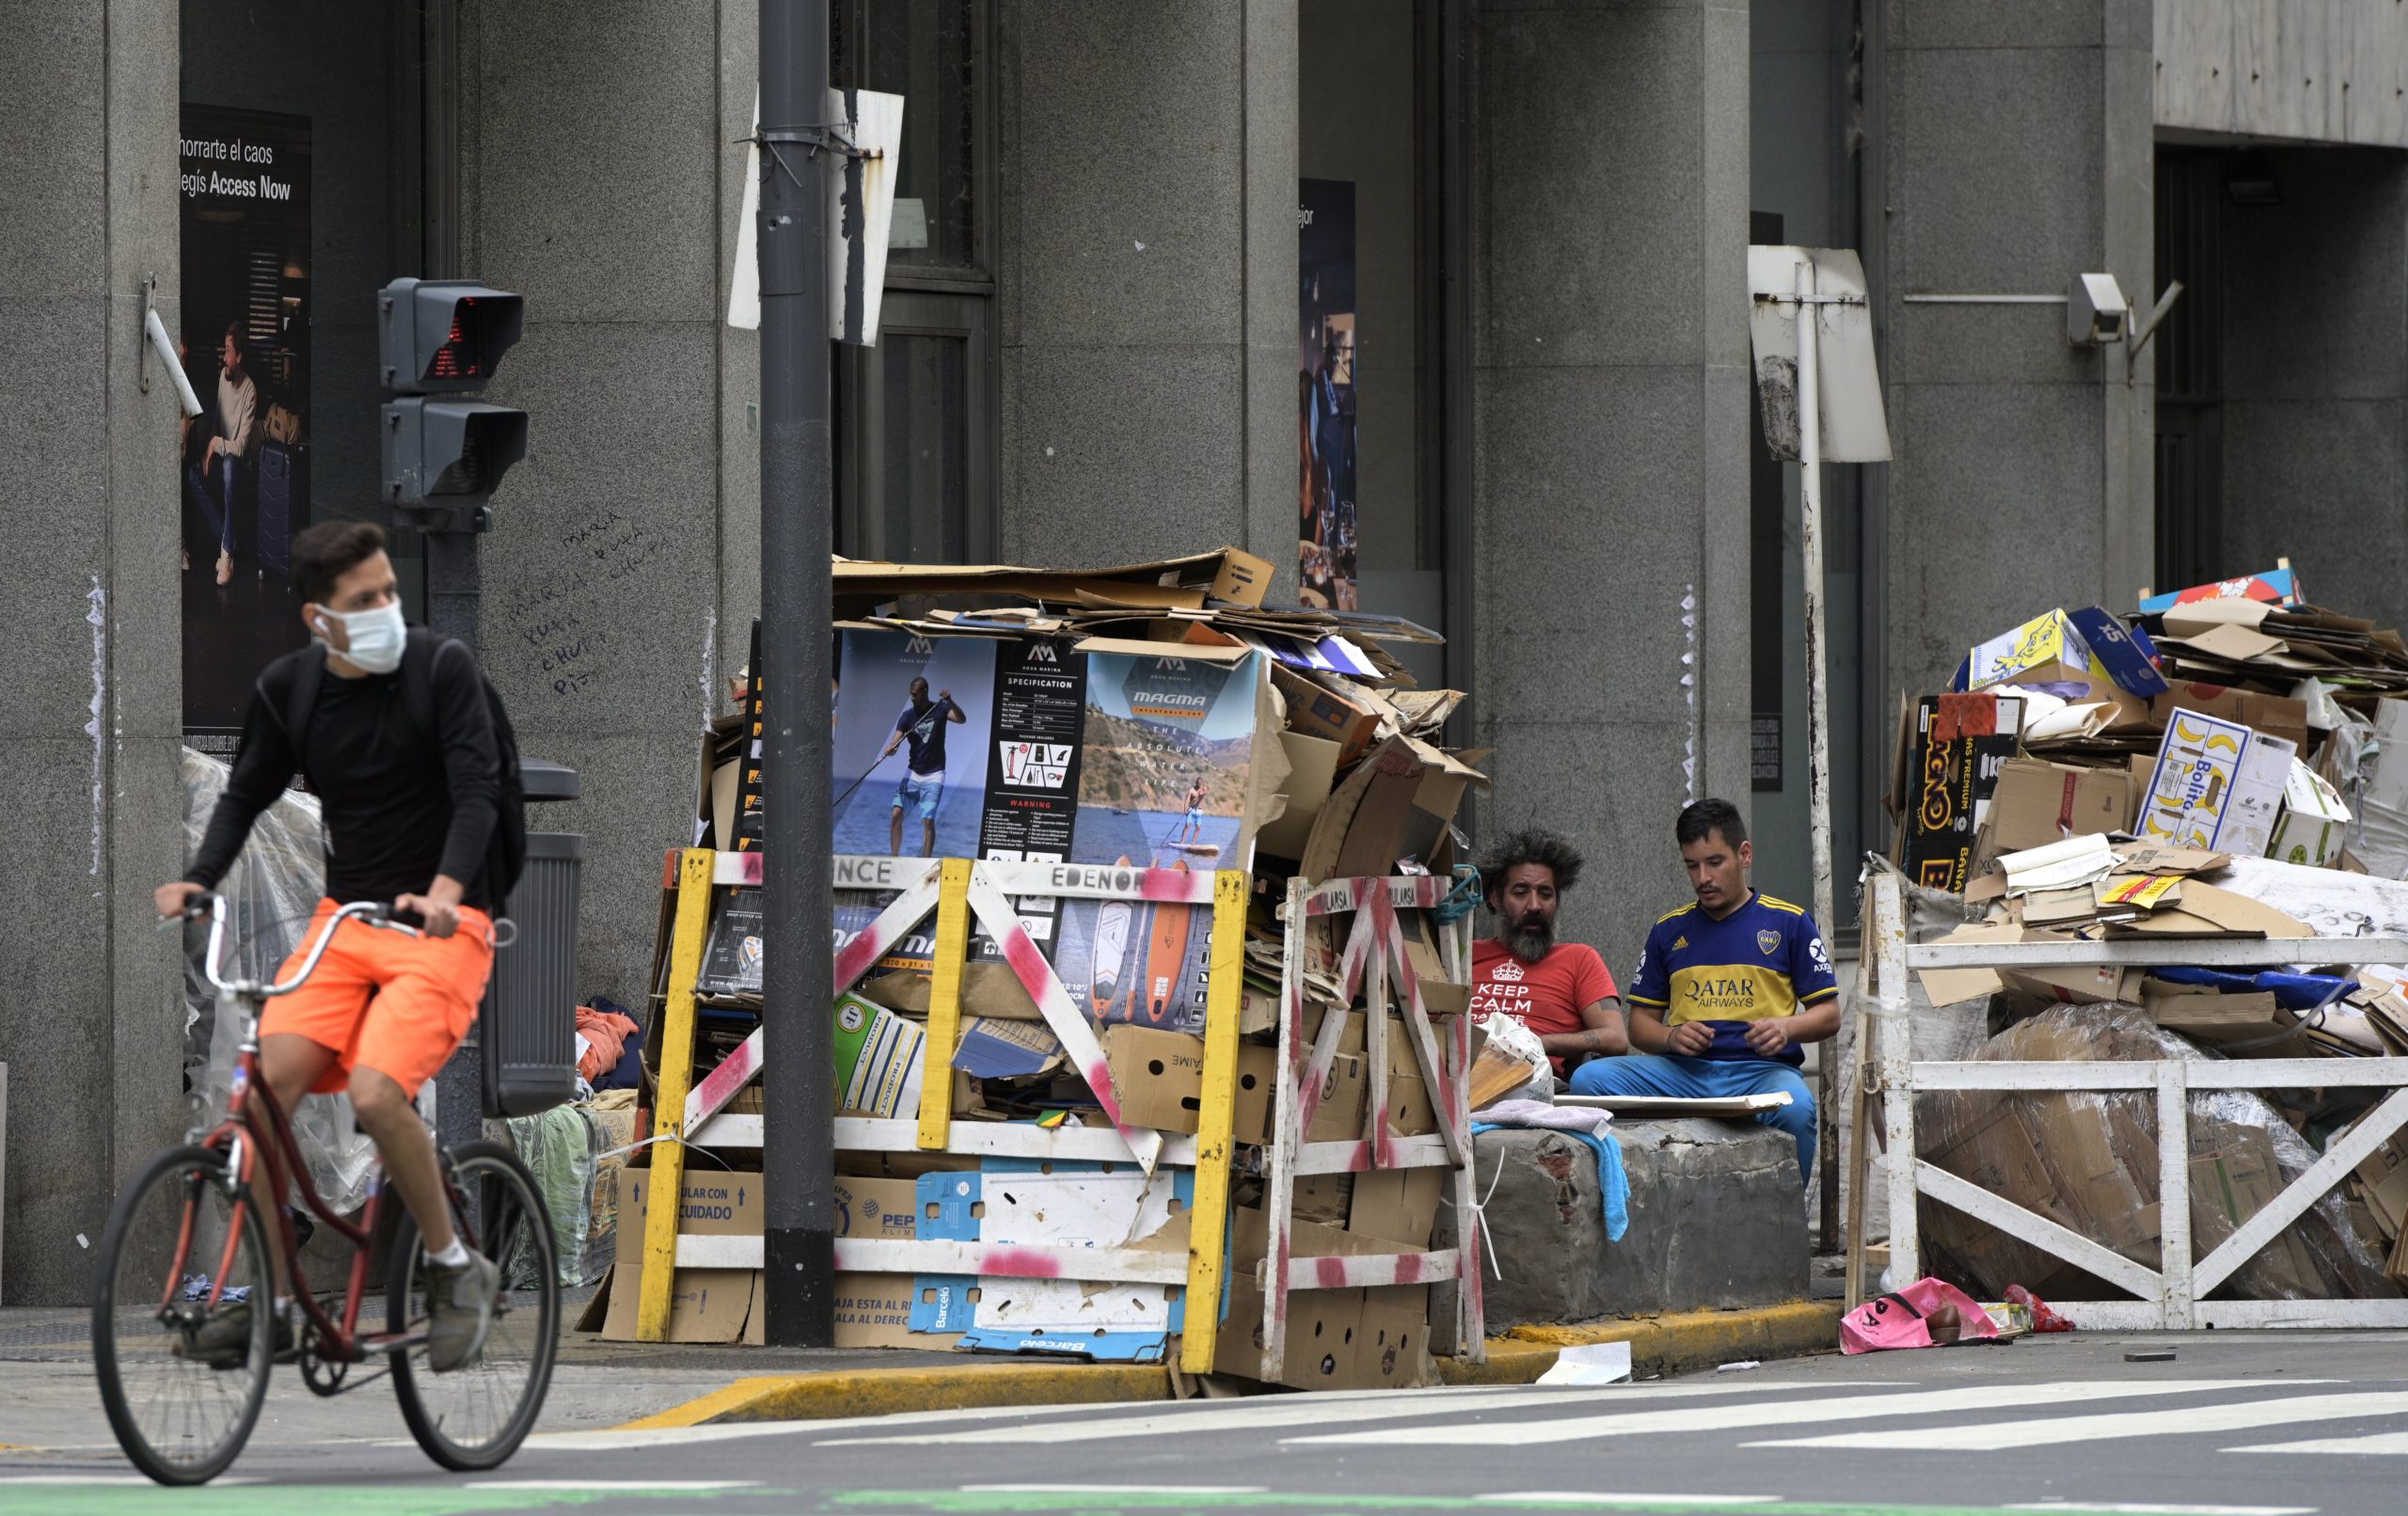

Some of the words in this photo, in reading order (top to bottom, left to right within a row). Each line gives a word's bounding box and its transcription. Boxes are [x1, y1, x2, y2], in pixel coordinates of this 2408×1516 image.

[230, 137, 241, 161] el
[245, 145, 273, 165] caos
[209, 170, 257, 197] Access
[260, 175, 291, 200] Now
[1007, 677, 1072, 688] SPECIFICATION
[1133, 691, 1207, 706] MAGMA
[1152, 726, 1178, 734] THE
[1127, 743, 1203, 754] ABSOLUTE
[1139, 760, 1185, 770] WATER
[1961, 761, 1972, 810] PREMIUM
[2183, 760, 2212, 811] Bolita
[1010, 799, 1053, 809] WARNING
[1478, 983, 1529, 997] KEEP
[1685, 978, 1754, 1001] QATAR
[1470, 996, 1531, 1013] CALM
[1697, 997, 1754, 1008] AIRWAYS
[861, 1016, 882, 1066] PRODUCT
[1172, 1055, 1203, 1068] AIME
[680, 1188, 705, 1198] ULAR
[707, 1189, 728, 1199] CON
[678, 1205, 732, 1220] CUIDADO
[881, 1228, 915, 1237] ALIM
[857, 1299, 882, 1310] ESTA
[885, 1300, 897, 1310] AL
[858, 1314, 871, 1324] AL
